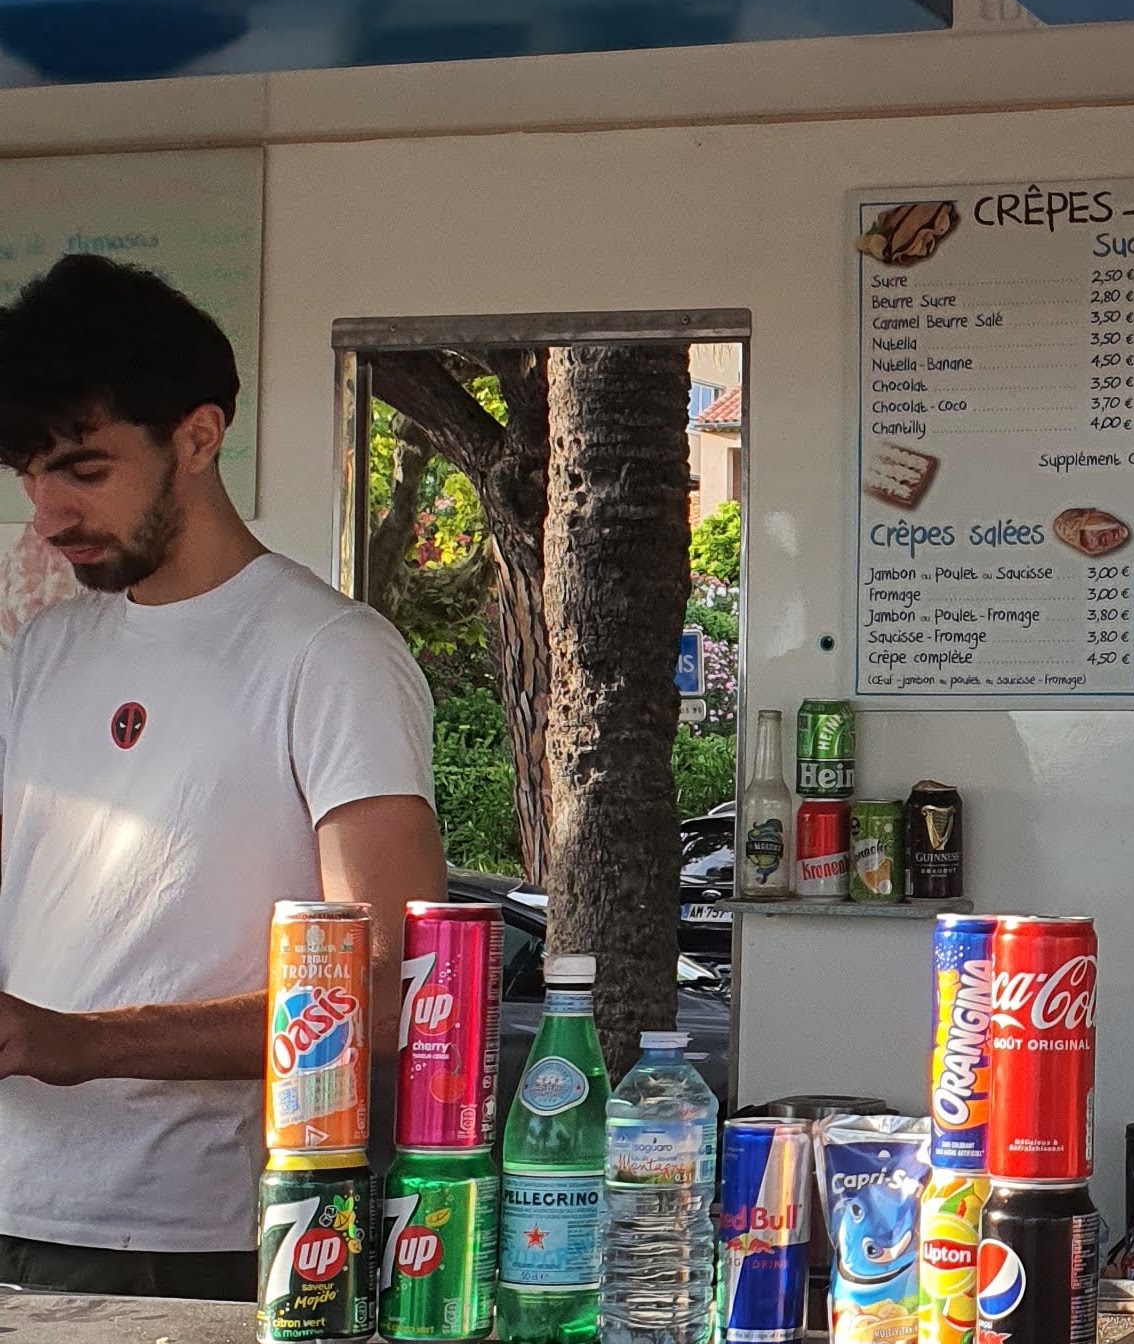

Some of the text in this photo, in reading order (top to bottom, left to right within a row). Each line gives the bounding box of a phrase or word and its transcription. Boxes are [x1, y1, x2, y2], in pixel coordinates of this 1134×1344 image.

[974, 184, 1114, 233] CRÊPES
[872, 275, 907, 288] Sucre
[1091, 270, 1122, 282] 2,50
[872, 295, 957, 308] Beurre Sucre
[1091, 291, 1121, 303] 2,80
[872, 313, 1003, 329] Caramel Beurre Salé
[1091, 311, 1121, 324] 3,50
[872, 337, 917, 350] Nutella
[1090, 333, 1121, 346] 3,50
[1090, 354, 1121, 367] 4,50
[872, 379, 928, 392] Chocolat
[1090, 376, 1121, 389] 3,50
[872, 399, 928, 413] Chocolat
[1091, 398, 1120, 411] 3,70
[872, 420, 926, 439] Chantilly
[1090, 417, 1122, 429] 4,00
[1039, 452, 1121, 473] Supplément
[870, 519, 955, 559] Crêpes
[865, 568, 916, 585] Jambon
[935, 568, 978, 582] Poulet
[996, 567, 1052, 579] Saucisse
[1087, 567, 1118, 580] 3,00
[869, 588, 921, 607] Fromage
[1087, 588, 1118, 601] 3,00
[864, 609, 916, 626] Jambon
[1087, 609, 1118, 622] 3,80
[868, 630, 987, 649] Saucisse Fromage
[1087, 631, 1118, 644] 3,80
[868, 650, 907, 670] Crêpe
[1087, 652, 1117, 665] 4,50
[915, 852, 960, 862] GUINNESS
[282, 964, 352, 979] TROPICAL
[272, 986, 360, 1075] Oasis
[934, 959, 992, 1125] ORANGINA
[1027, 1038, 1090, 1051] ORIGINAL
[751, 1206, 797, 1231] Bull
[924, 1243, 972, 1264] Lipton
